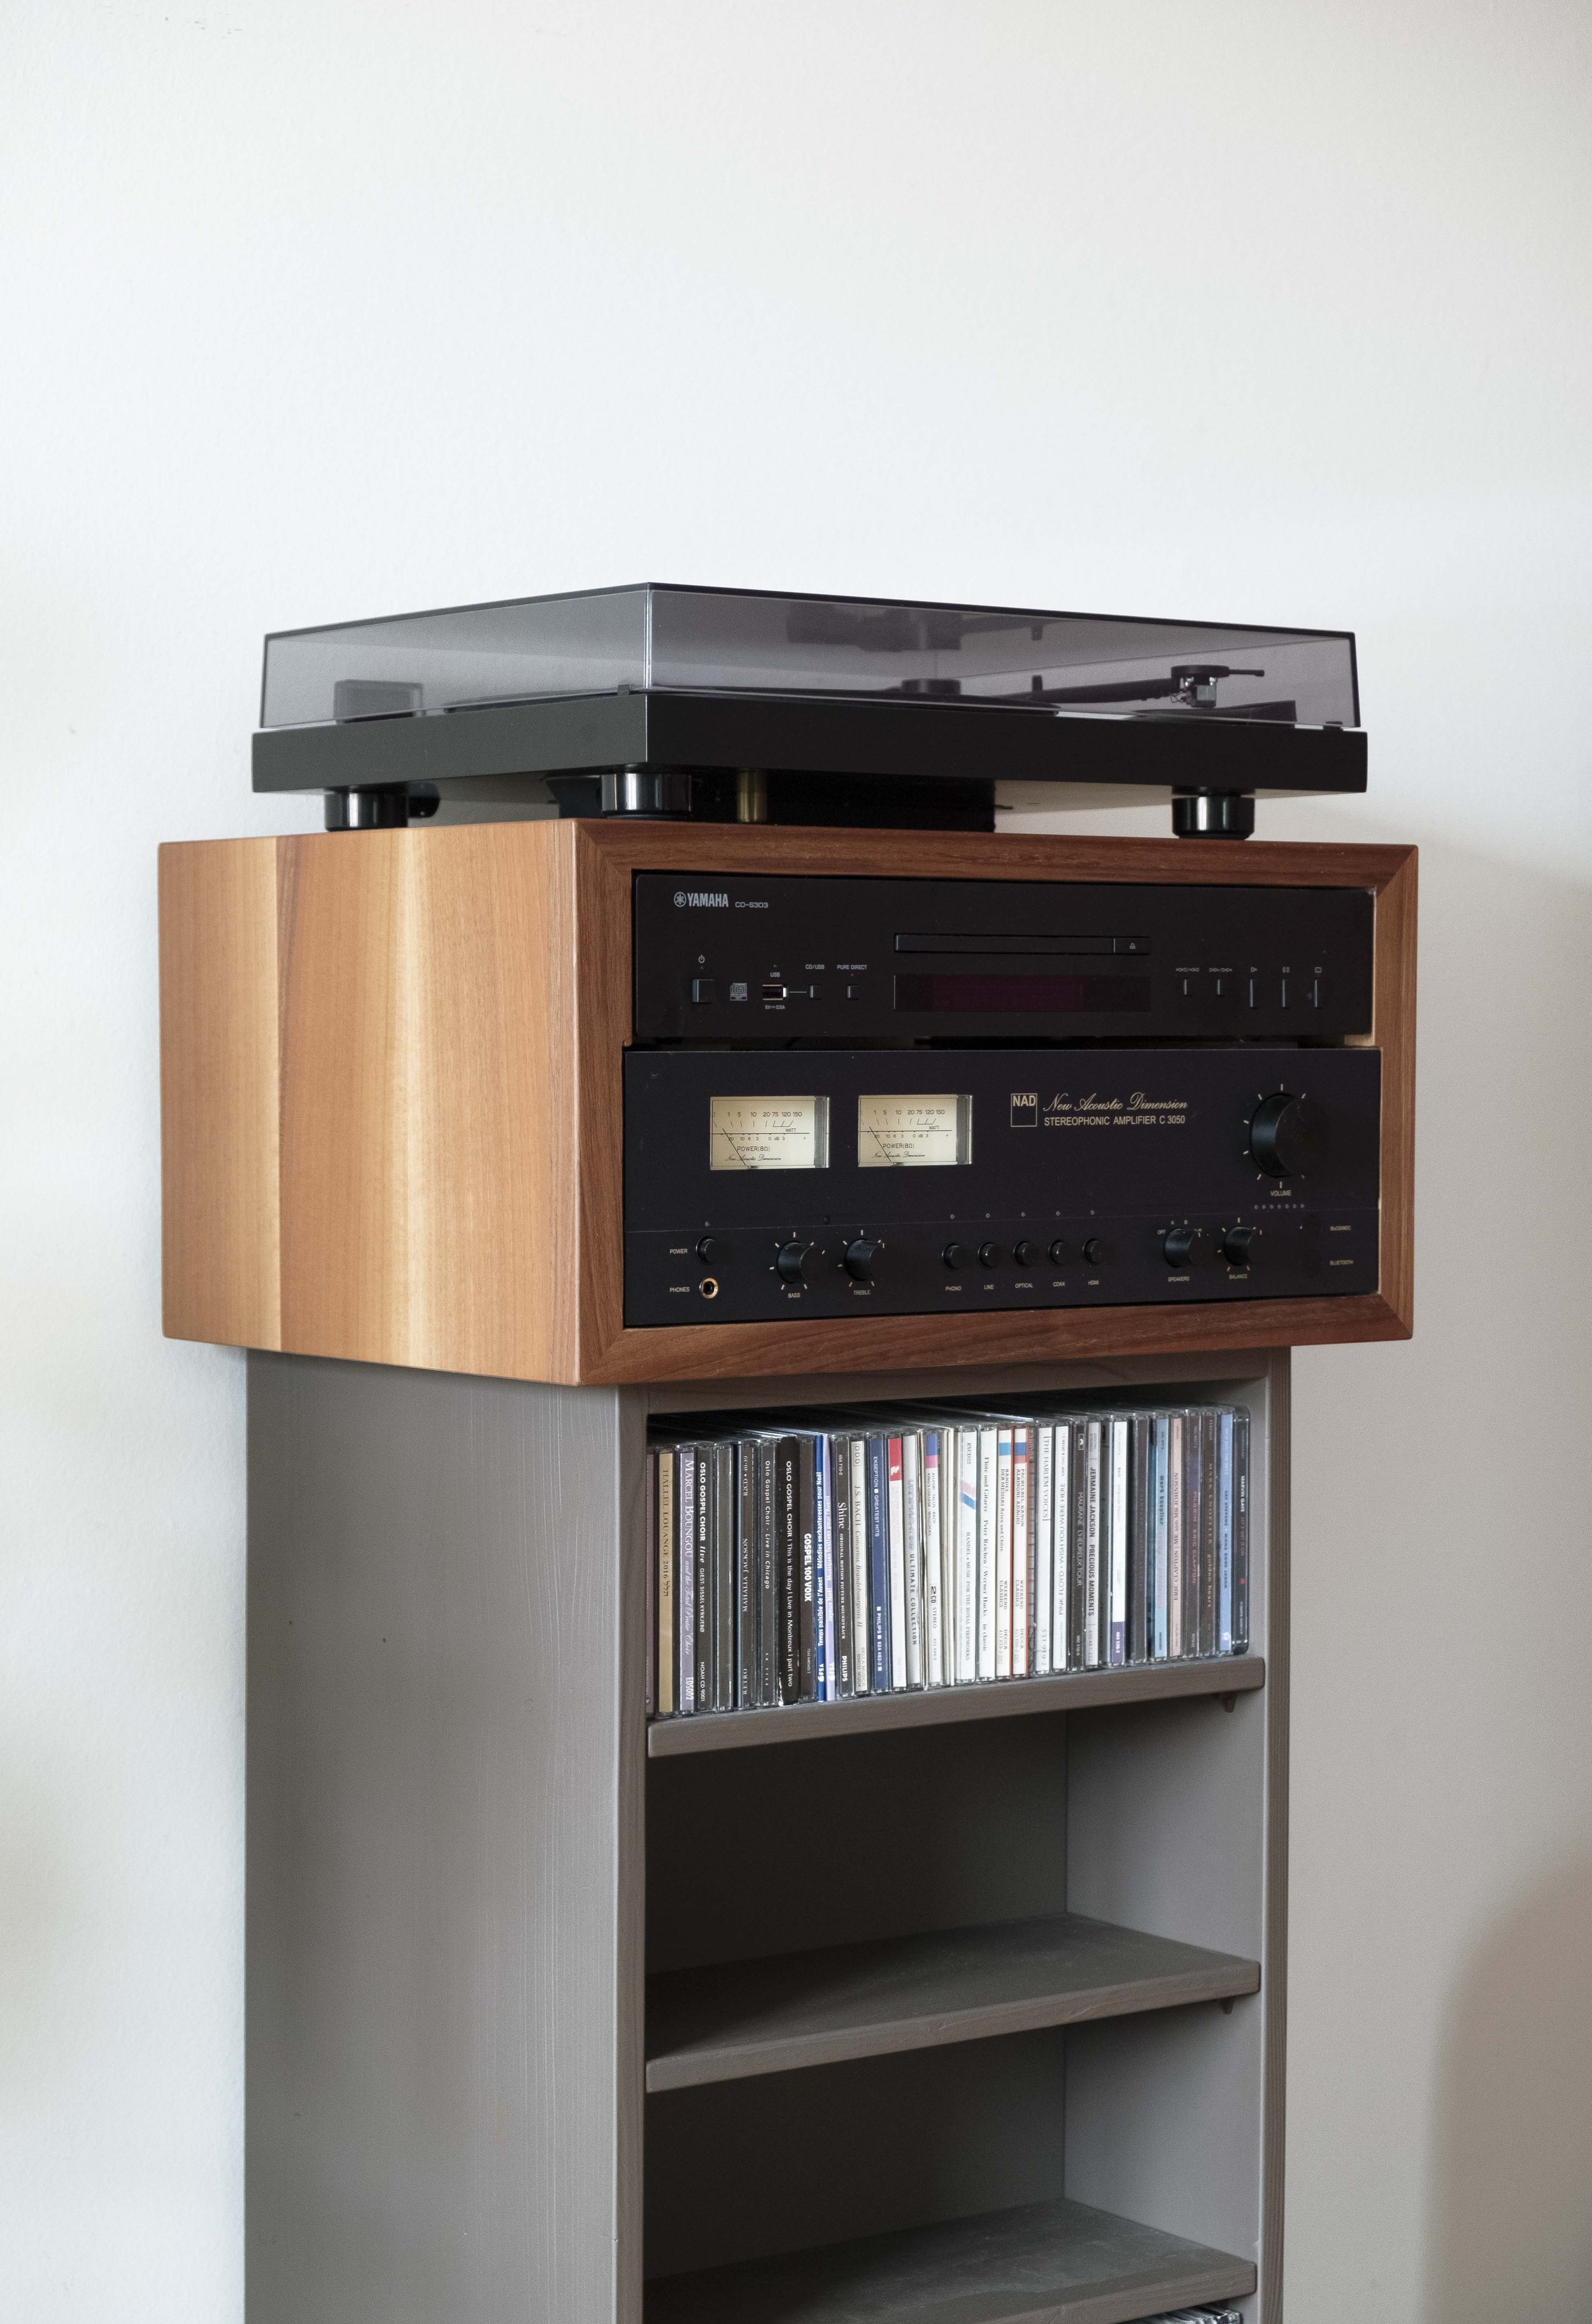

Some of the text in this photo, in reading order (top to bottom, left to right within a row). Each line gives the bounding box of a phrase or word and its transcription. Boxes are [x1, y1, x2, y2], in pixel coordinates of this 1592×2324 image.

[687, 893, 728, 907] YAMAHA
[1013, 1095, 1035, 1107] NAD
[1043, 1092, 1188, 1112] New Acoustic Dimension
[1044, 1116, 1185, 1126] STEREOPHONIC AMPLIFIER C 3050
[685, 1459, 694, 1503] MARCEL
[837, 1503, 846, 1529] Shine
[1174, 1507, 1178, 1518] MR
[685, 1505, 693, 1557] BOUNGOU
[1174, 1534, 1178, 1545] ME
[685, 1585, 693, 1605] Total
[684, 1607, 693, 1631] Praise
[685, 1635, 693, 1655] Choir
[700, 1680, 705, 1688] CD
